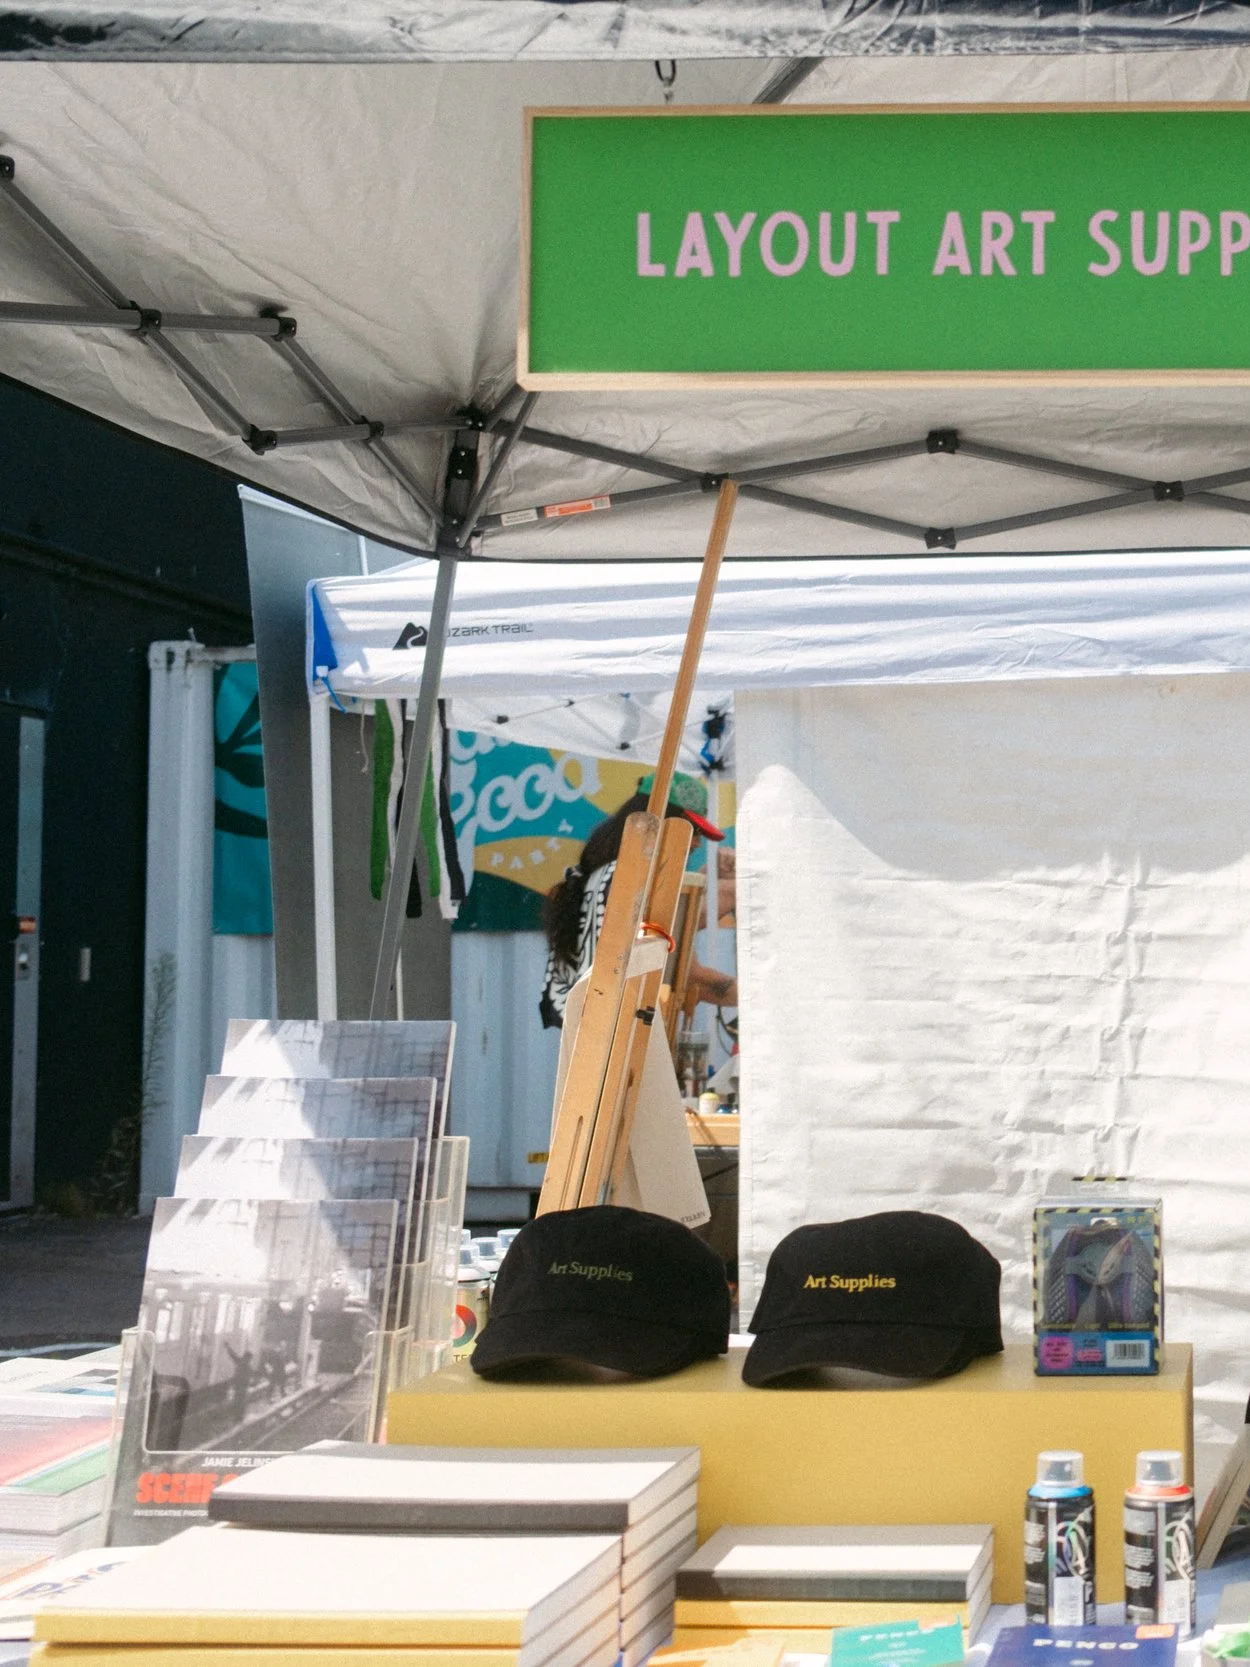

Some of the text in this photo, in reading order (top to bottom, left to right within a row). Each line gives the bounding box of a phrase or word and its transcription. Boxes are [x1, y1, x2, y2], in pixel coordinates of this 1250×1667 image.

[636, 210, 901, 278] LAYOUT
[933, 210, 1056, 277] ART
[447, 627, 489, 637] ZARK
[548, 1261, 633, 1283] Art Supplies
[803, 1273, 896, 1293] Art Supplies
[201, 1456, 276, 1468] JAMIE JELINS
[1032, 1638, 1139, 1650] PENCO
